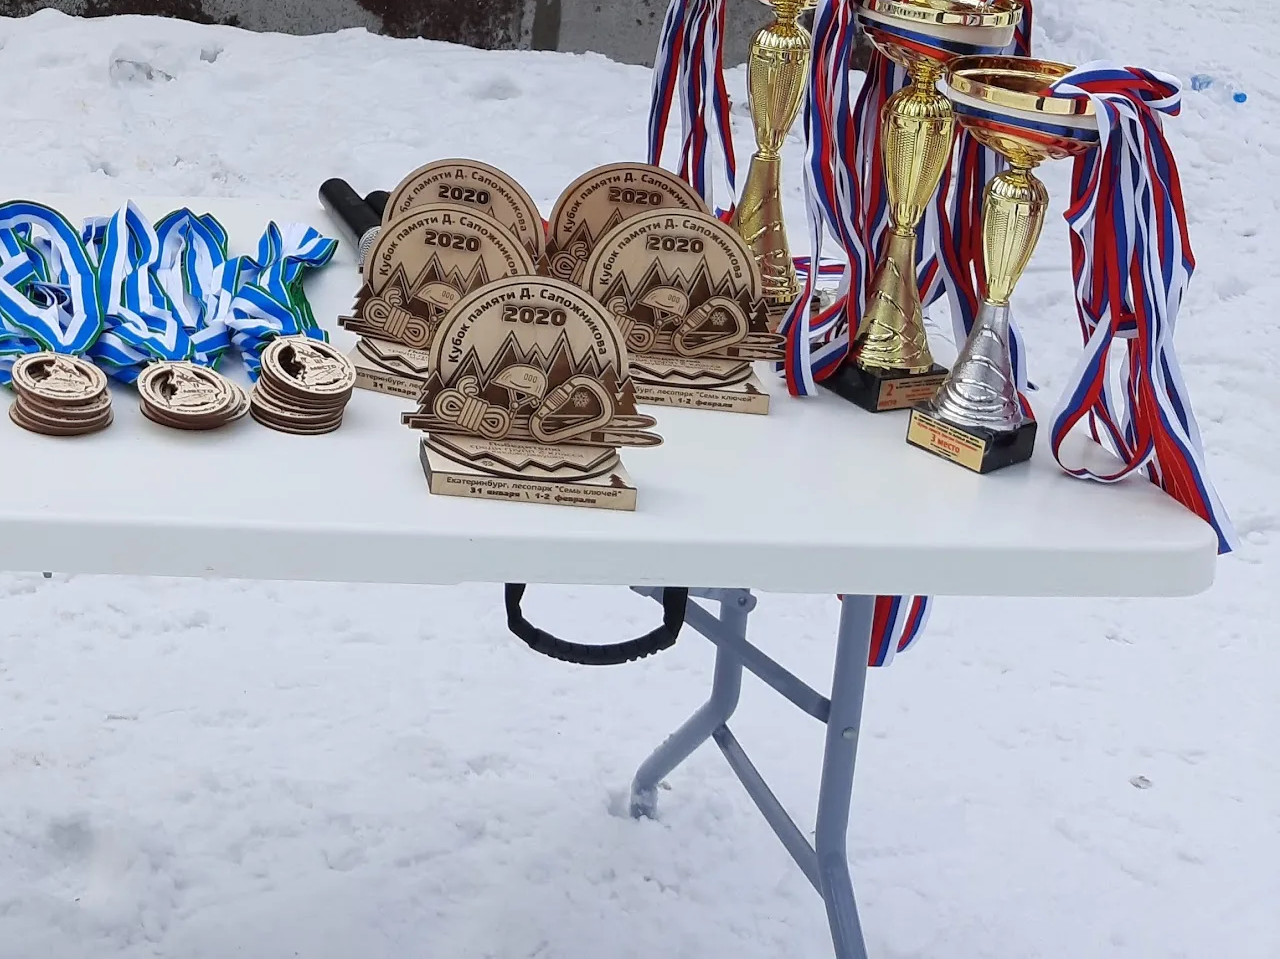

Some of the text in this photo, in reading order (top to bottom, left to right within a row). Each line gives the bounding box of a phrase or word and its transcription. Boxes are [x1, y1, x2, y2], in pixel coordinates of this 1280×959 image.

[399, 169, 527, 232] бок памяти Д. Сапожникова
[438, 184, 491, 205] 2020
[563, 172, 690, 233] Кубок памяти Д. Сапожни
[608, 186, 663, 206] 2020
[379, 214, 518, 276] Кубок памяти Д. Сапожников
[424, 229, 482, 252] 2020
[645, 234, 704, 254] 2020
[599, 219, 743, 285] Кубок памяти Д. Сапожникова
[448, 287, 607, 363] Кубок памяти Д. Сапожникова
[502, 304, 567, 327] 2020
[357, 372, 407, 387] катеринбург,
[886, 383, 894, 397] 2
[657, 389, 694, 398] лесопарк
[930, 433, 936, 443] 3
[936, 436, 960, 454] место
[446, 476, 622, 498] Екатеринбург, лесопарк "Семь ключей"
[469, 486, 483, 494] 31
[486, 489, 520, 498] января
[534, 493, 550, 501] 1-2
[554, 494, 597, 505] февраля
